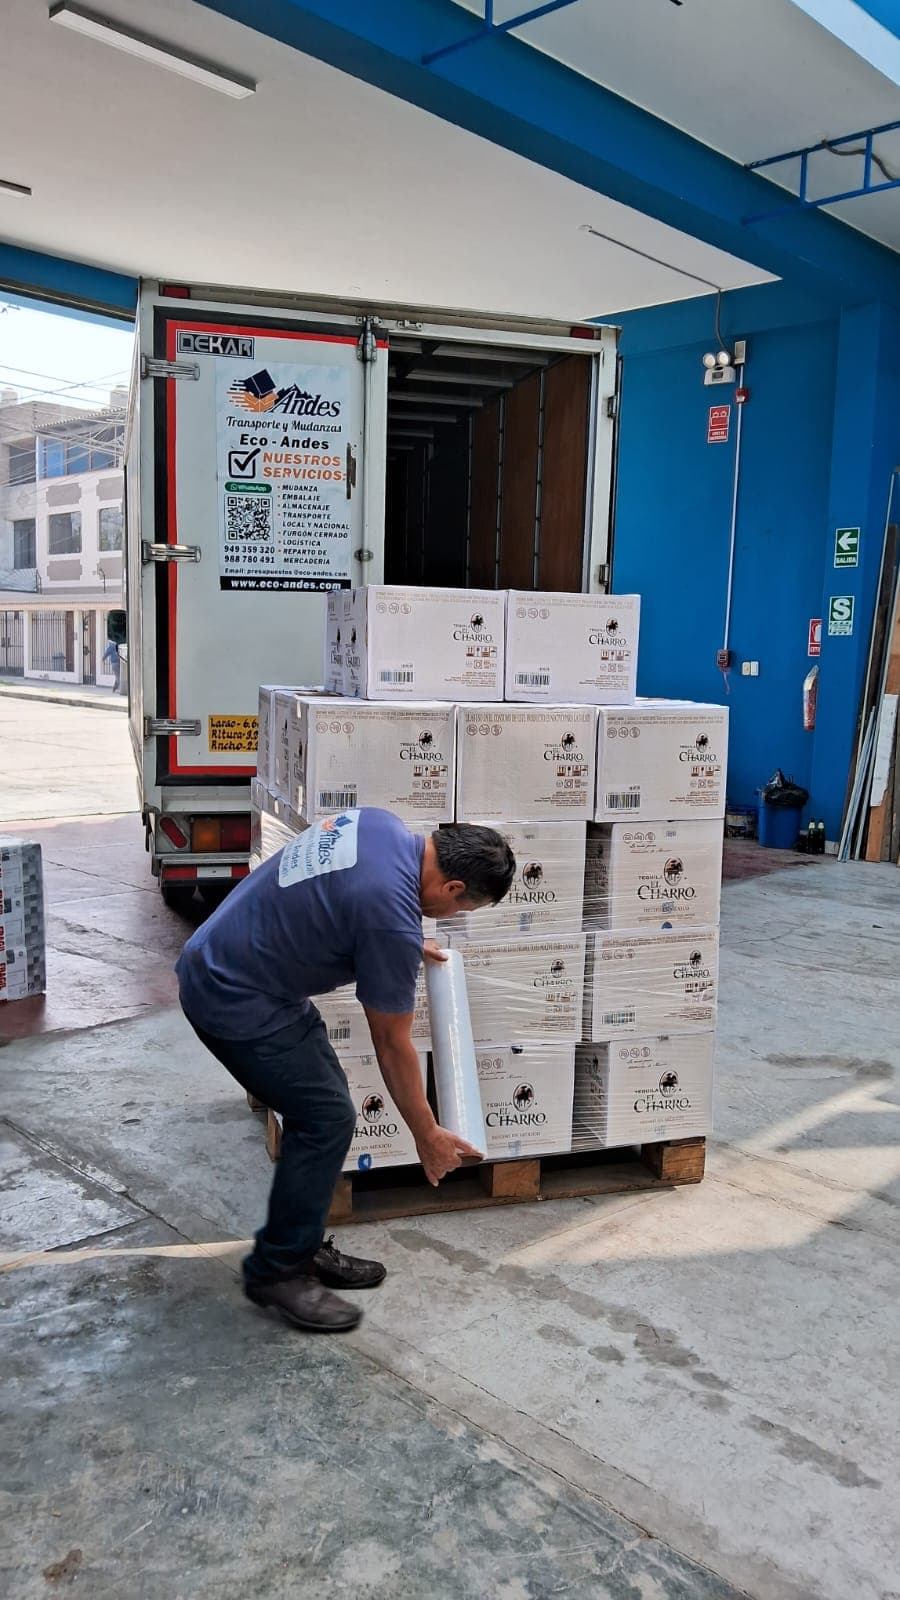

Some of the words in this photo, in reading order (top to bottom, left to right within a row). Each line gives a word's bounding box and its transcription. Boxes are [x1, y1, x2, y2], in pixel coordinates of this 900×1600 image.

[181, 335, 252, 357] DEKAR
[270, 391, 341, 417] Andes
[226, 416, 280, 431] Transporte
[282, 422, 289, 432] y
[291, 419, 342, 432] Mudanzas
[240, 434, 268, 446] Eco
[280, 436, 329, 450] Andes
[263, 453, 341, 467] NUESTROS
[263, 467, 347, 481] SERVICIOS:
[282, 503, 330, 511] ALMACENAJE
[282, 520, 305, 528] LOCAL
[313, 522, 350, 530] NACIONAL
[224, 545, 240, 553] 949
[242, 545, 258, 553] 359
[260, 546, 275, 554] 320
[283, 548, 316, 556] REPARTO
[224, 555, 240, 563] 988
[242, 555, 258, 563] 780
[260, 556, 275, 564] 491
[231, 579, 342, 590] www.eco-andes.com
[832, 599, 851, 620] S
[453, 630, 492, 643] CHARRO
[589, 634, 627, 647] CHARRO
[400, 749, 443, 763] CHARRO
[543, 750, 584, 763] CHARRO
[679, 751, 717, 763] CHARRO
[500, 890, 557, 904] HARRO
[637, 884, 695, 901] CHARRO
[673, 967, 710, 979] CHARRO
[500, 1107, 510, 1115] EL
[633, 1097, 690, 1113] CHARRO
[486, 1112, 546, 1127] CHARRO
